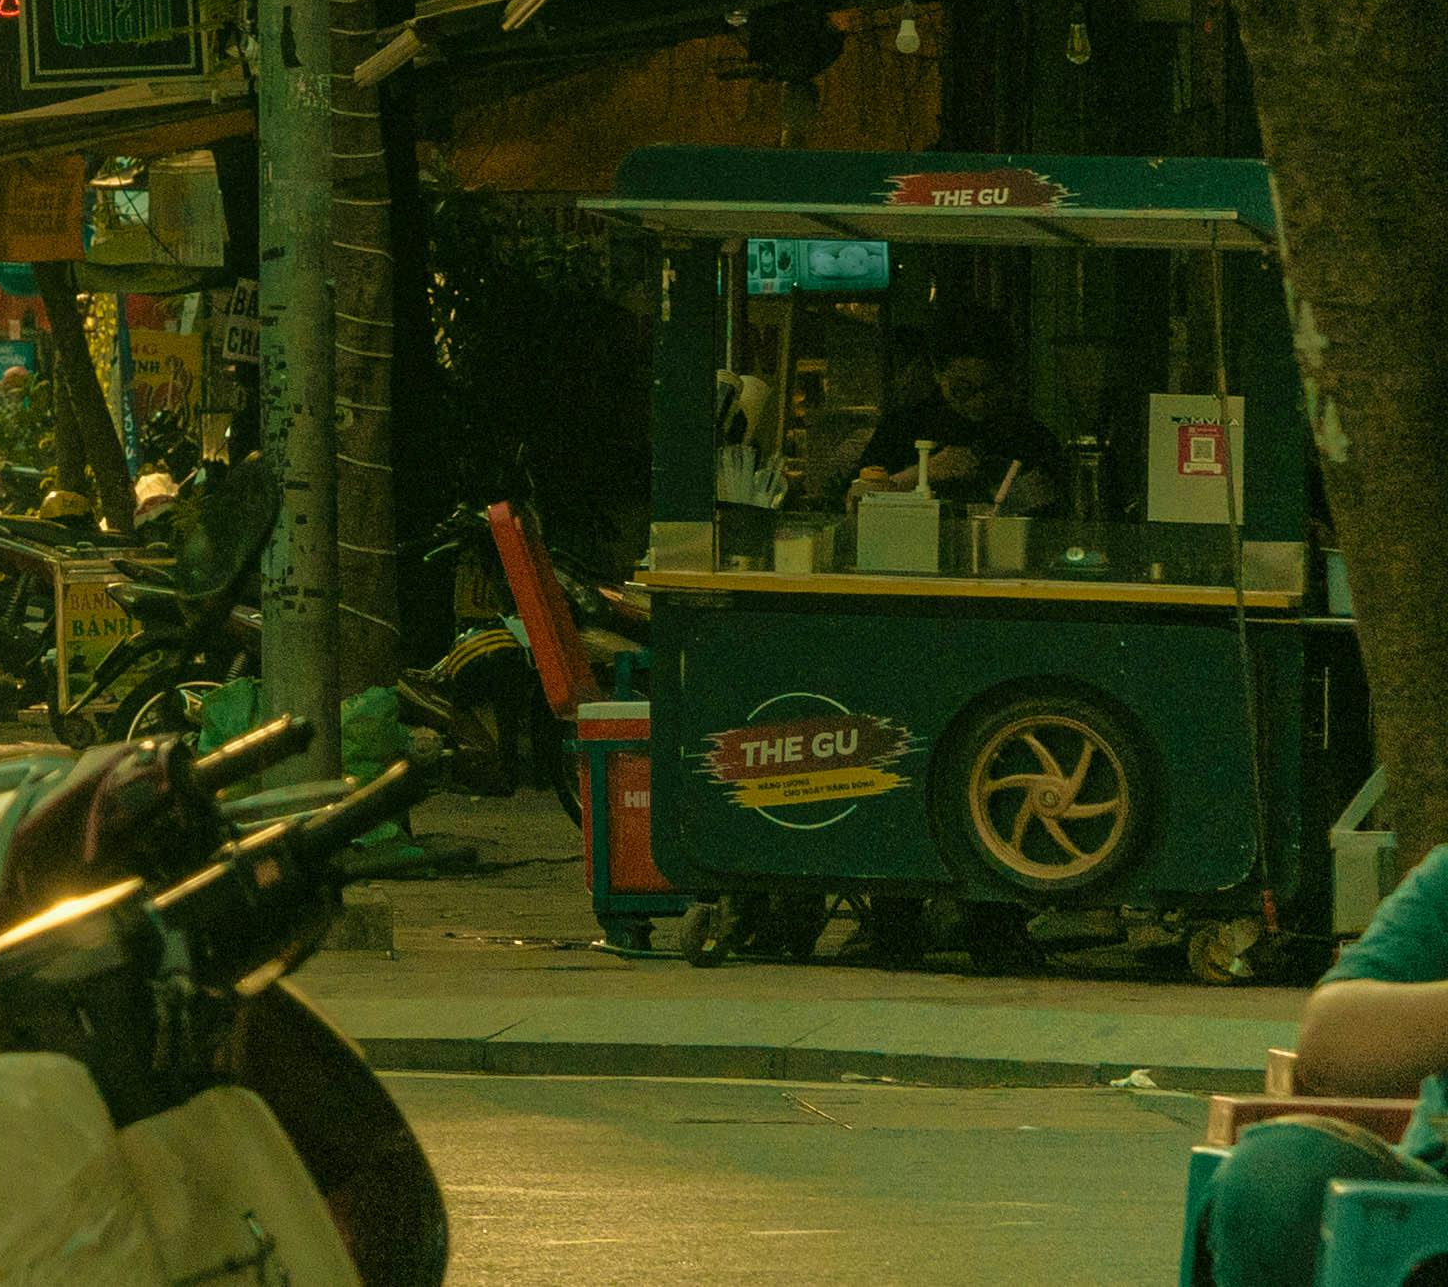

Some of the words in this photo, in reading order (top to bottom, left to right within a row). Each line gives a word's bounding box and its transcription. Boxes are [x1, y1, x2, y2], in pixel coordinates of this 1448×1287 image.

[932, 189, 973, 206] THE
[977, 187, 1009, 205] GU
[740, 737, 803, 767] THE
[812, 729, 859, 758] GU
